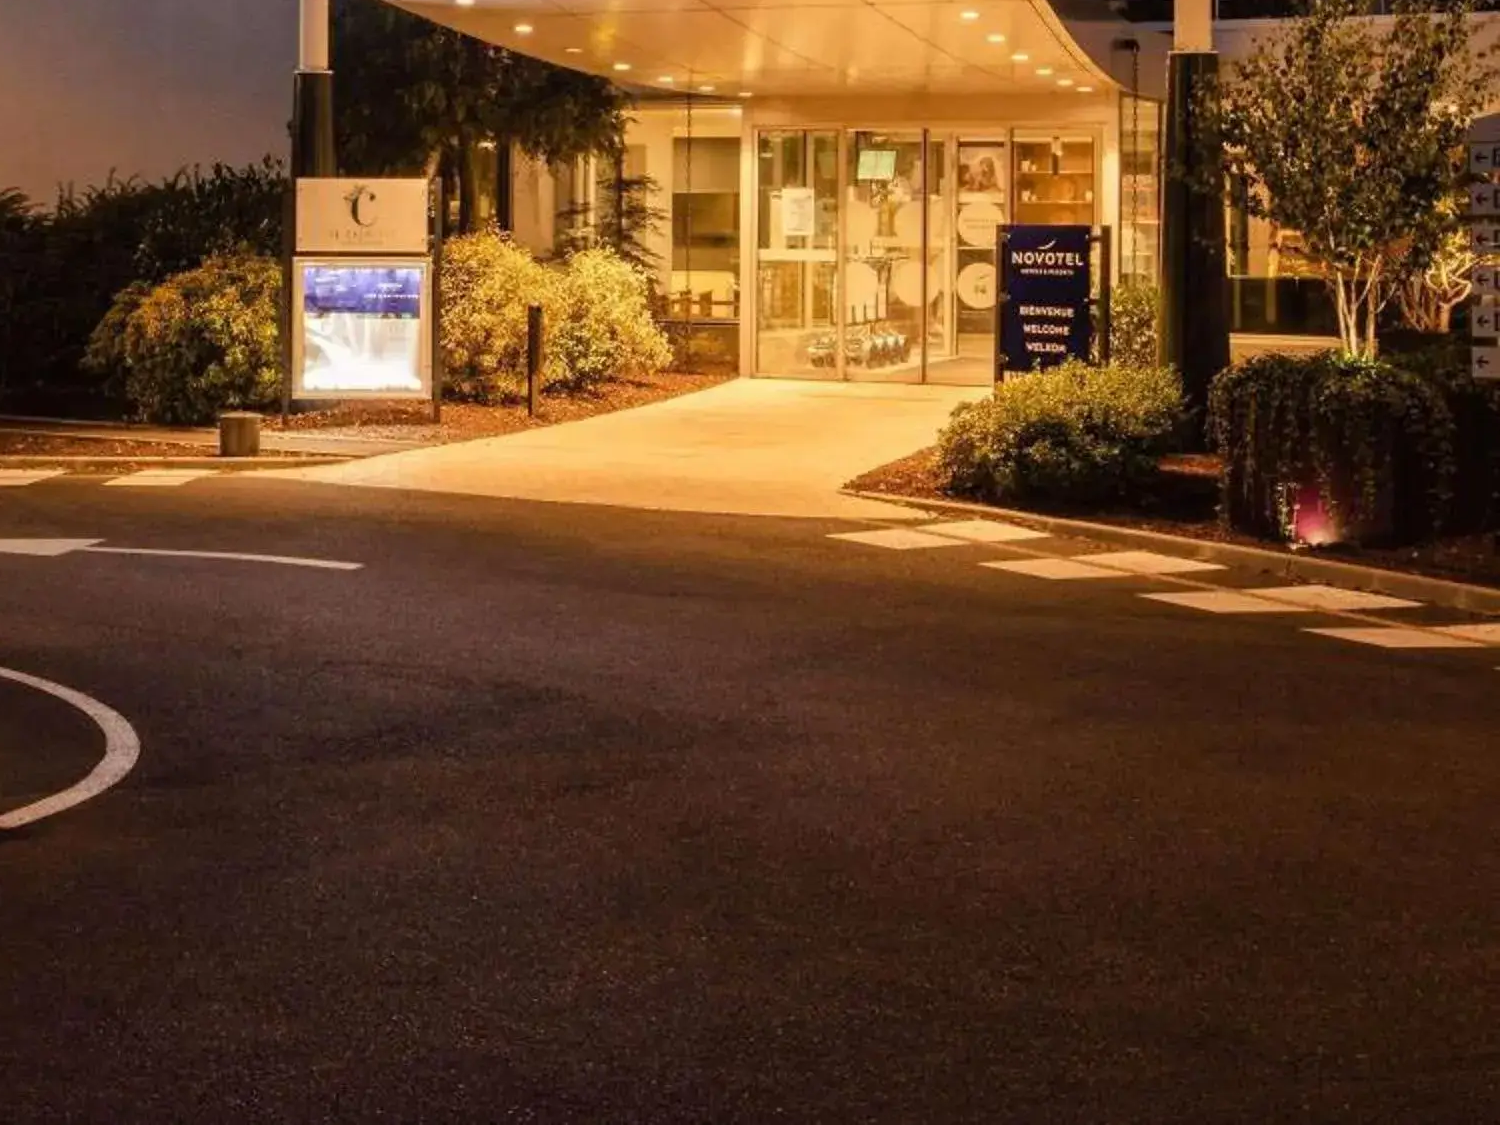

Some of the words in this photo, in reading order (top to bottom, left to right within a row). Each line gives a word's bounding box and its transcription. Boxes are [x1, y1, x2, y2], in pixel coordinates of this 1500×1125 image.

[1011, 251, 1084, 266] NOVOTEL
[1019, 305, 1075, 318] BIENVENUE
[1023, 324, 1070, 336] WELCOME
